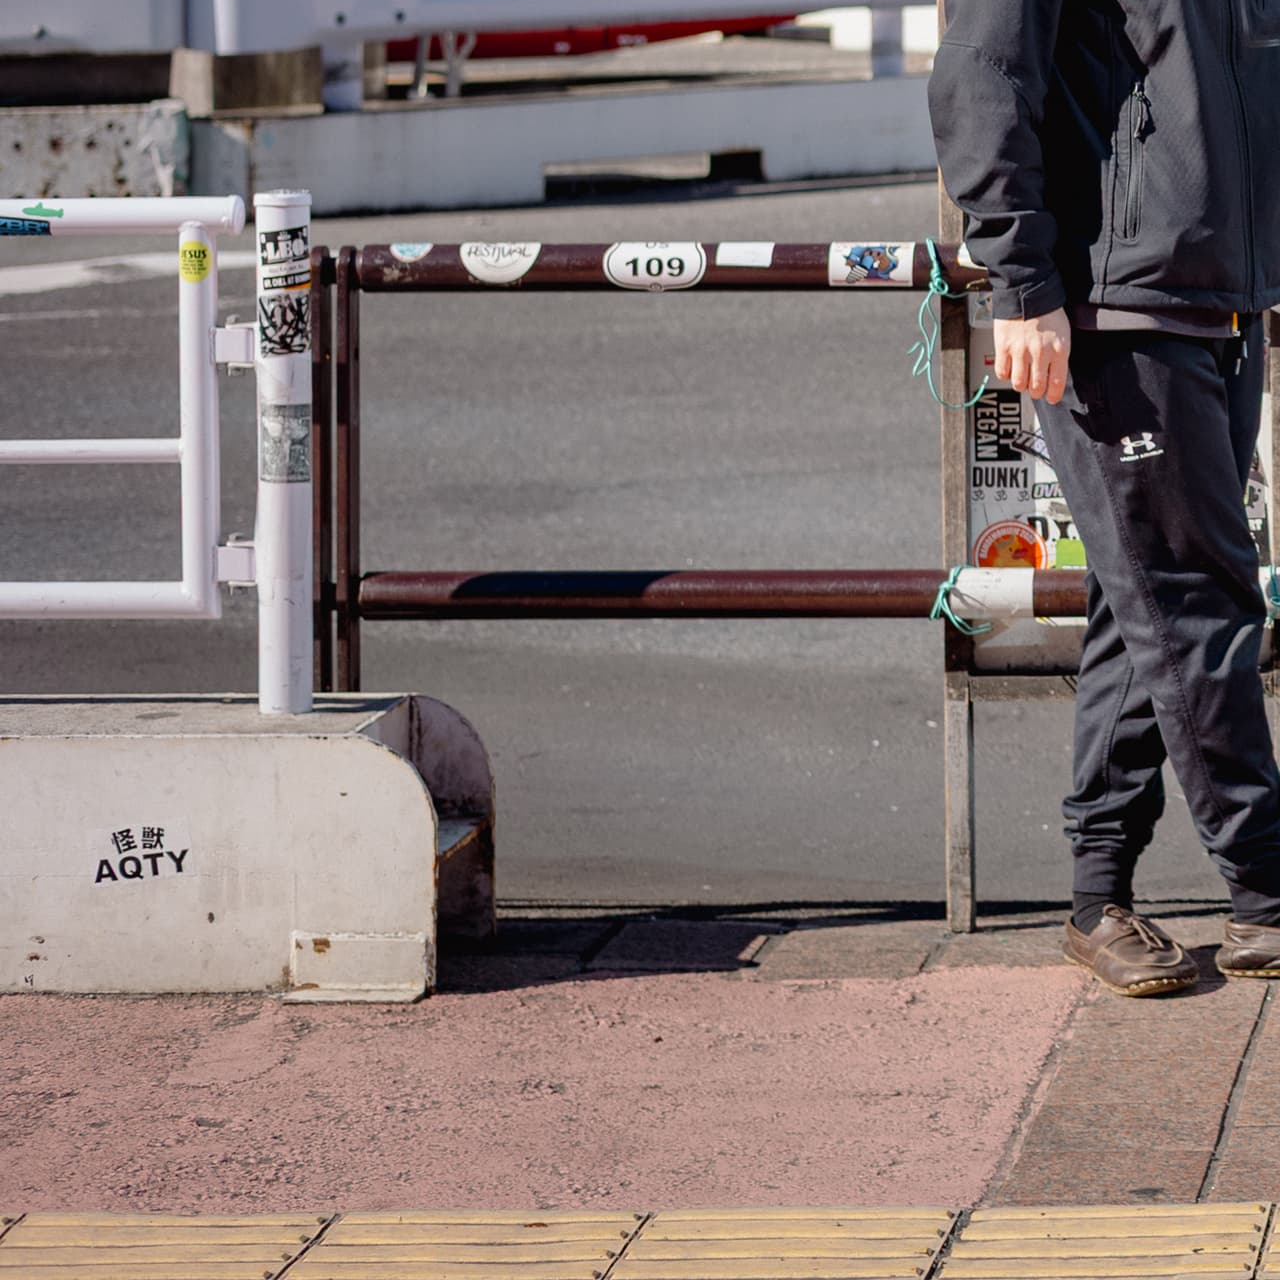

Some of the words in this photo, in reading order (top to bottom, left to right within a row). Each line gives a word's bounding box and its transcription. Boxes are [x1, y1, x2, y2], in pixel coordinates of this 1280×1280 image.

[179, 247, 208, 261] JESUS
[624, 258, 686, 278] 109
[975, 391, 998, 460] VEGAN
[972, 466, 1030, 489] DUNK1
[112, 826, 165, 854] 怪獣
[95, 849, 189, 883] AQTY
